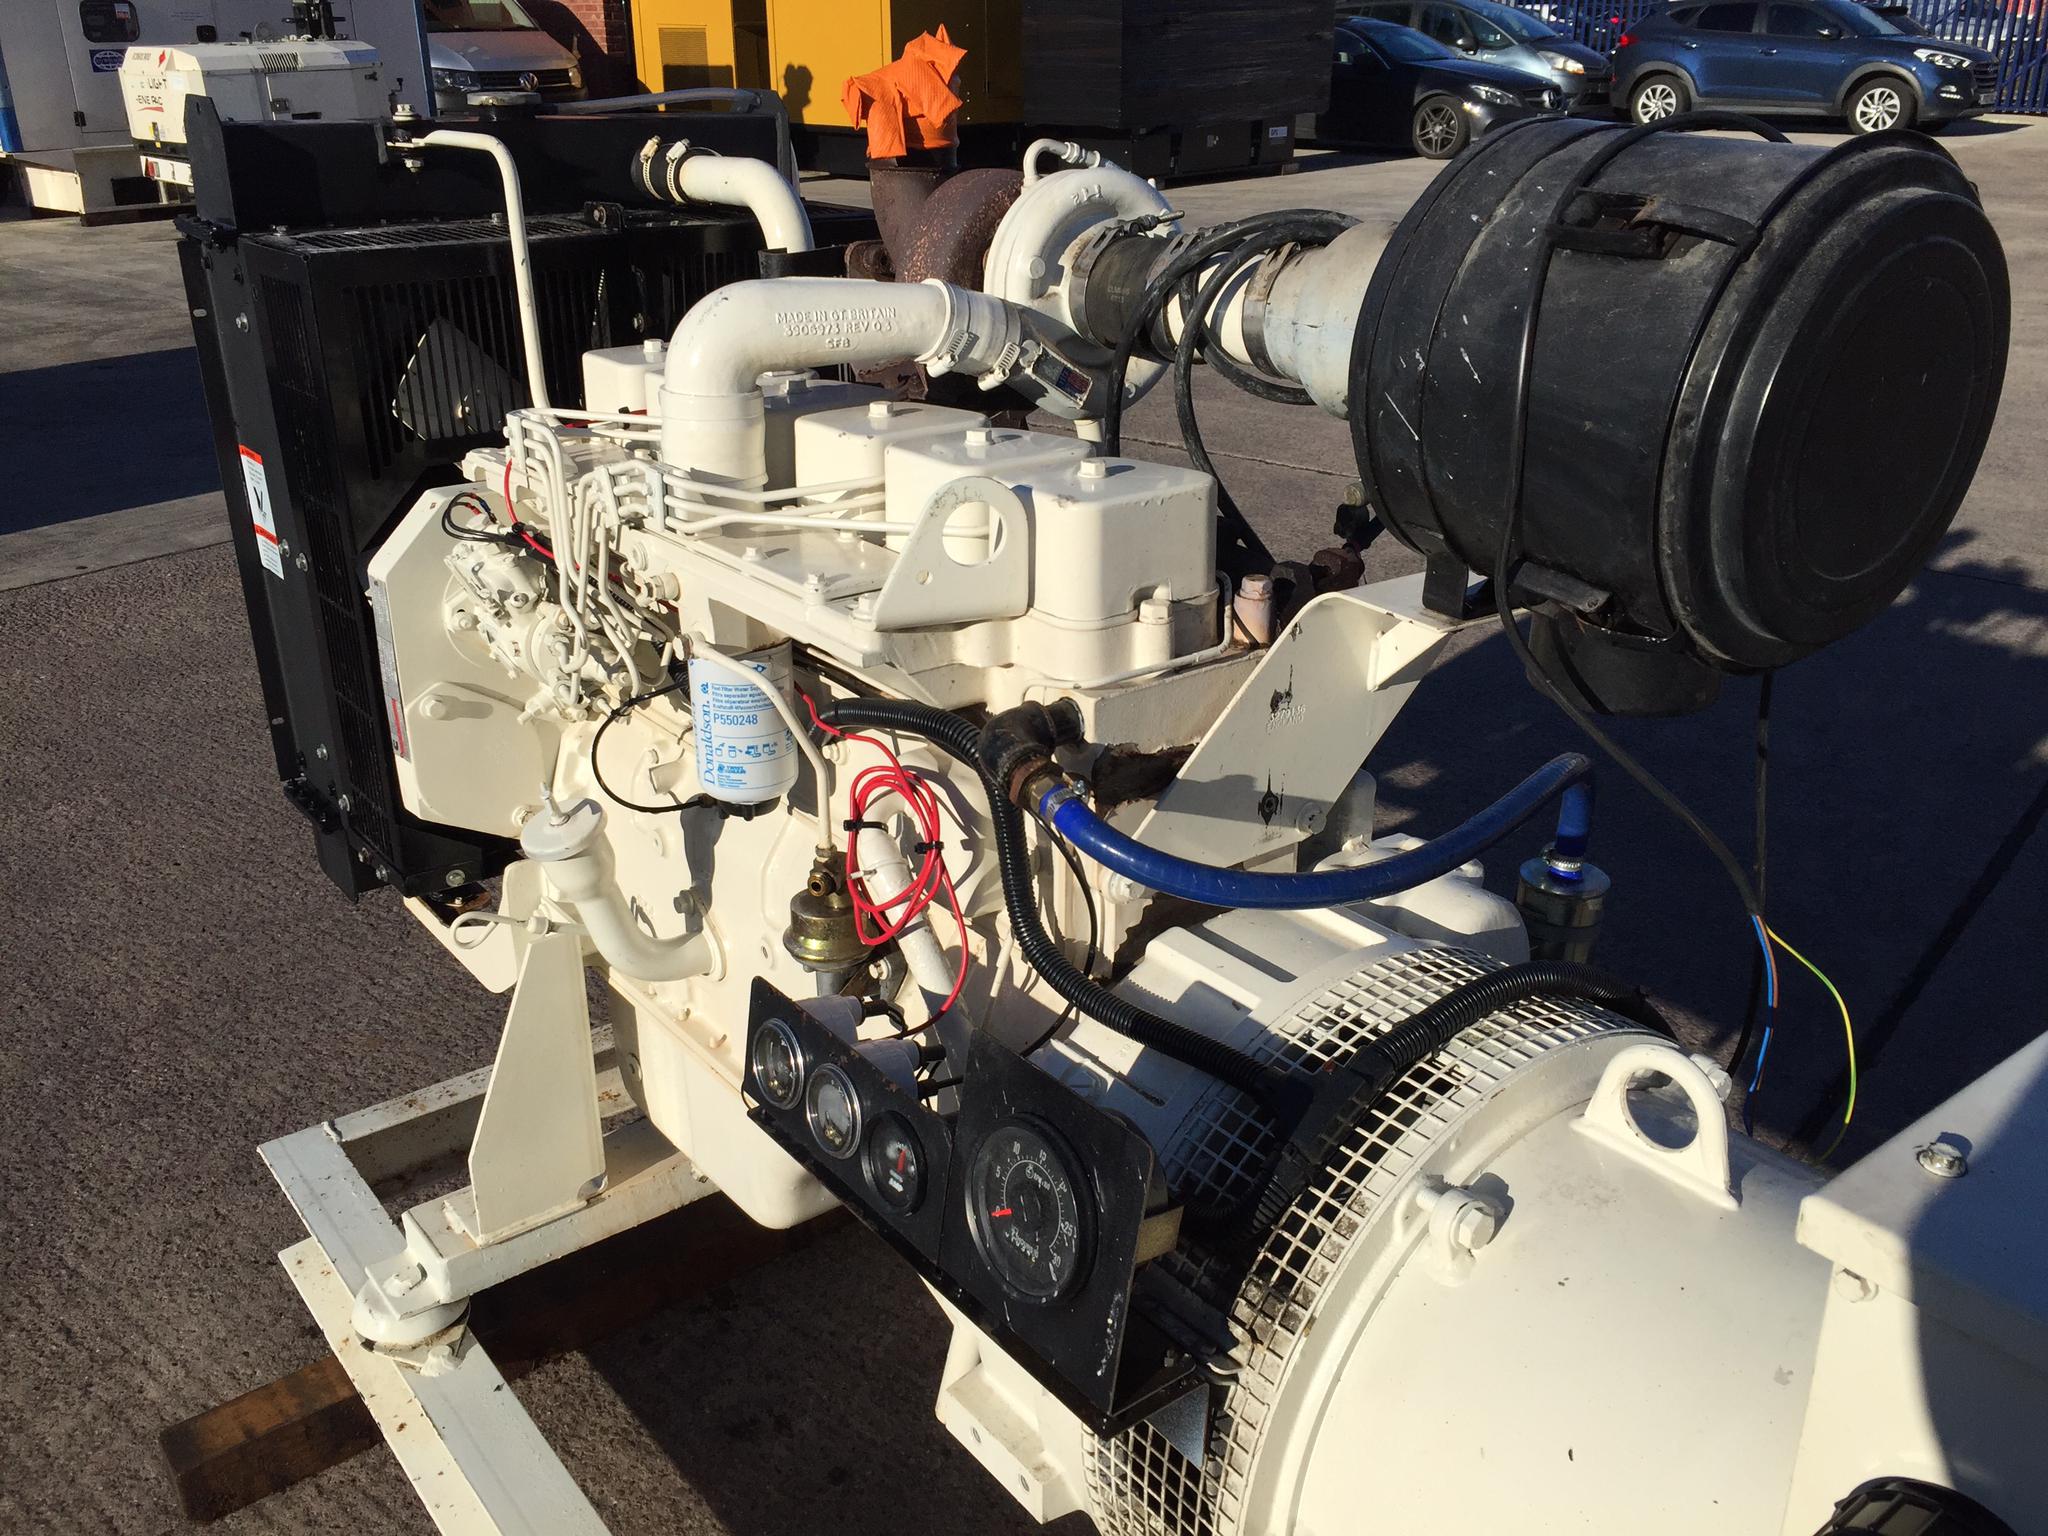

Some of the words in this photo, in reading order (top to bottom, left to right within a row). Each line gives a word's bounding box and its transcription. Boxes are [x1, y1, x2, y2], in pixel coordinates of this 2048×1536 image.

[775, 310, 812, 324] MADE
[814, 309, 828, 322] IN
[849, 306, 897, 321] BRITAIN
[844, 319, 870, 333] REV
[713, 713, 759, 726] P550248
[1013, 1141, 1021, 1155] 10
[995, 1165, 1001, 1178] 5
[1063, 1220, 1074, 1237] 25
[1052, 1251, 1061, 1266] 30
